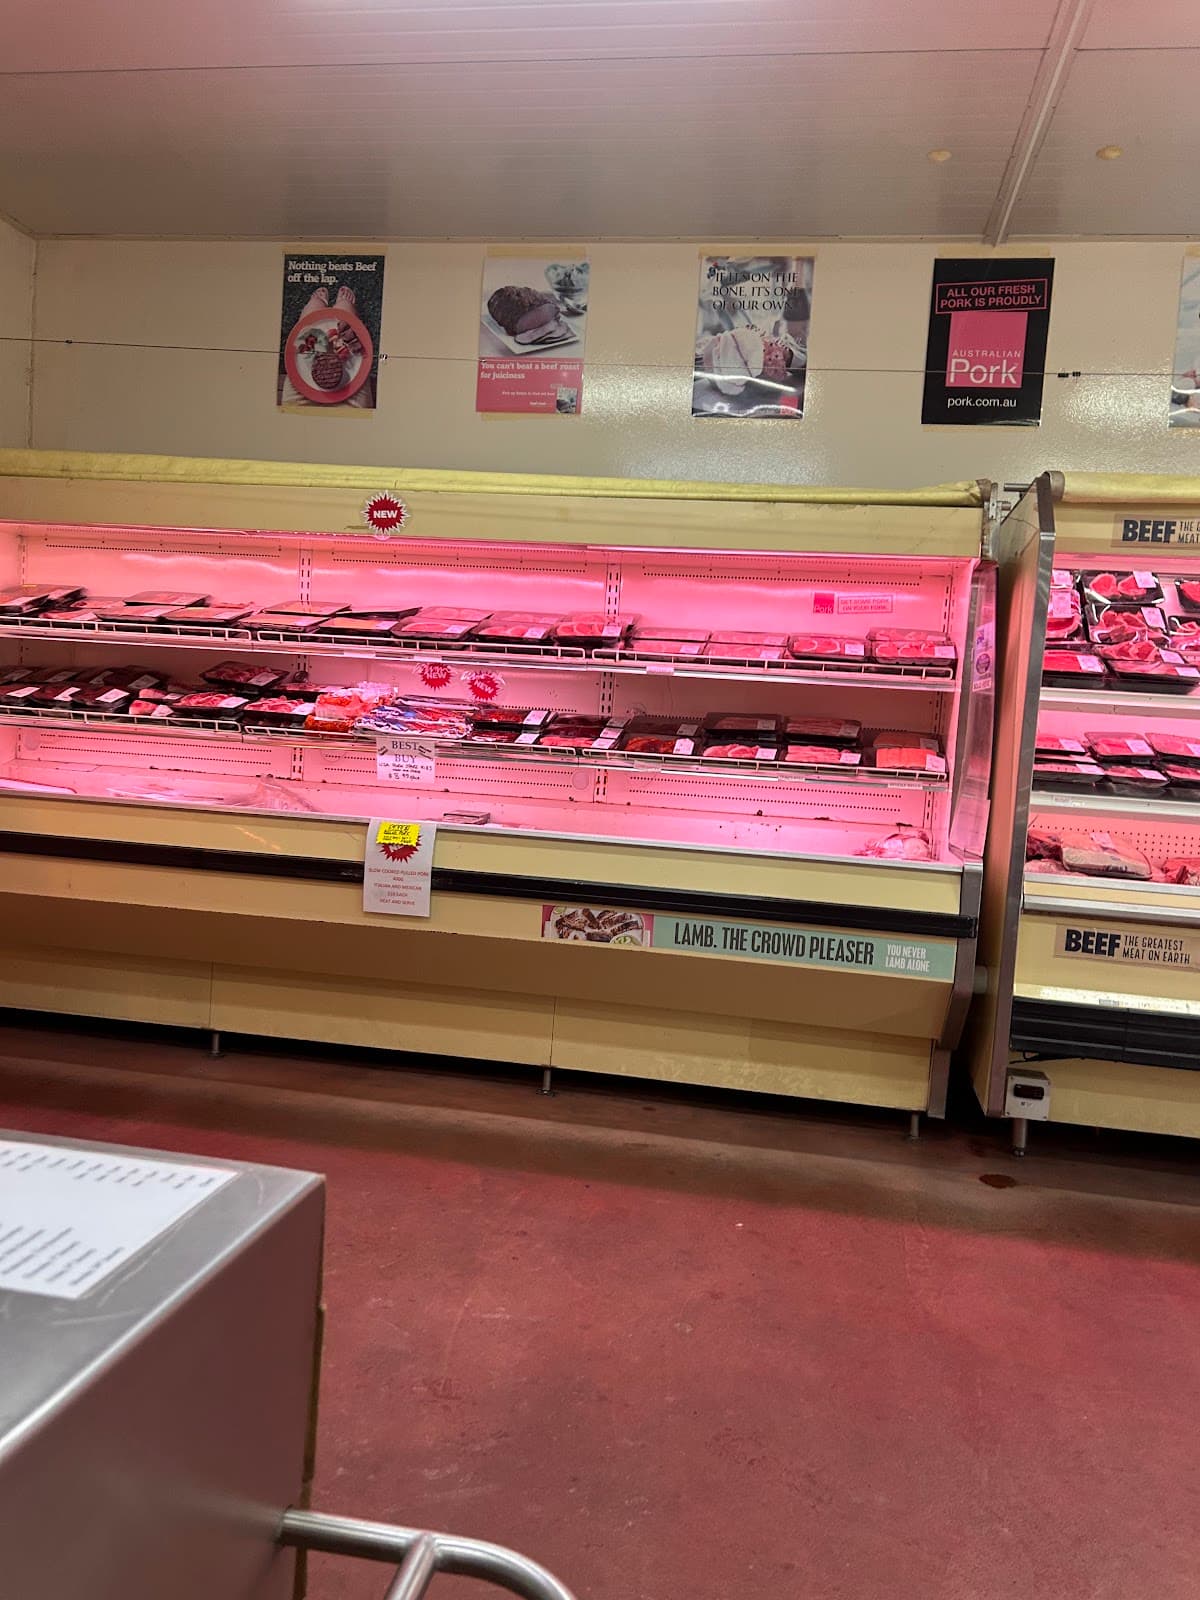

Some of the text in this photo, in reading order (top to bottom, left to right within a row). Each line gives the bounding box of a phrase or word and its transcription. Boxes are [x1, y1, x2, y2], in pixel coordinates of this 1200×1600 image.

[288, 260, 378, 273] Nothing beats Beef
[287, 273, 338, 285] off the lap.
[716, 272, 723, 282] IF
[751, 273, 770, 283] ON
[775, 273, 798, 283] THE
[712, 286, 799, 297] BONE, IT'S ONE
[946, 284, 1036, 297] ALL OUR FRESH
[712, 300, 726, 310] OF
[732, 300, 758, 310] OUR
[940, 295, 1042, 309] PORK IS PROUDLY
[952, 350, 1022, 358] AUSTRALIAN
[481, 362, 495, 370] You
[496, 362, 515, 370] can't
[516, 362, 533, 370] beat
[948, 359, 1017, 385] Pork
[480, 371, 526, 380] for juiciness
[947, 397, 1017, 408] pork.com.au
[373, 510, 398, 519] NEW
[1122, 520, 1176, 543] BEEF
[1180, 522, 1194, 532] THE
[814, 605, 833, 614] Pork
[473, 680, 494, 694] NEW
[392, 740, 418, 750] BEST
[394, 754, 417, 763] BUY
[674, 922, 874, 965] LAMB. THE CROWD PLEASER
[1065, 928, 1121, 956] BEEF
[1124, 935, 1184, 951] THE GREATEST
[886, 944, 927, 959] YOU NEVER
[1122, 948, 1190, 964] MEAT ON EARTH
[885, 955, 930, 973] LAMB ALONE
